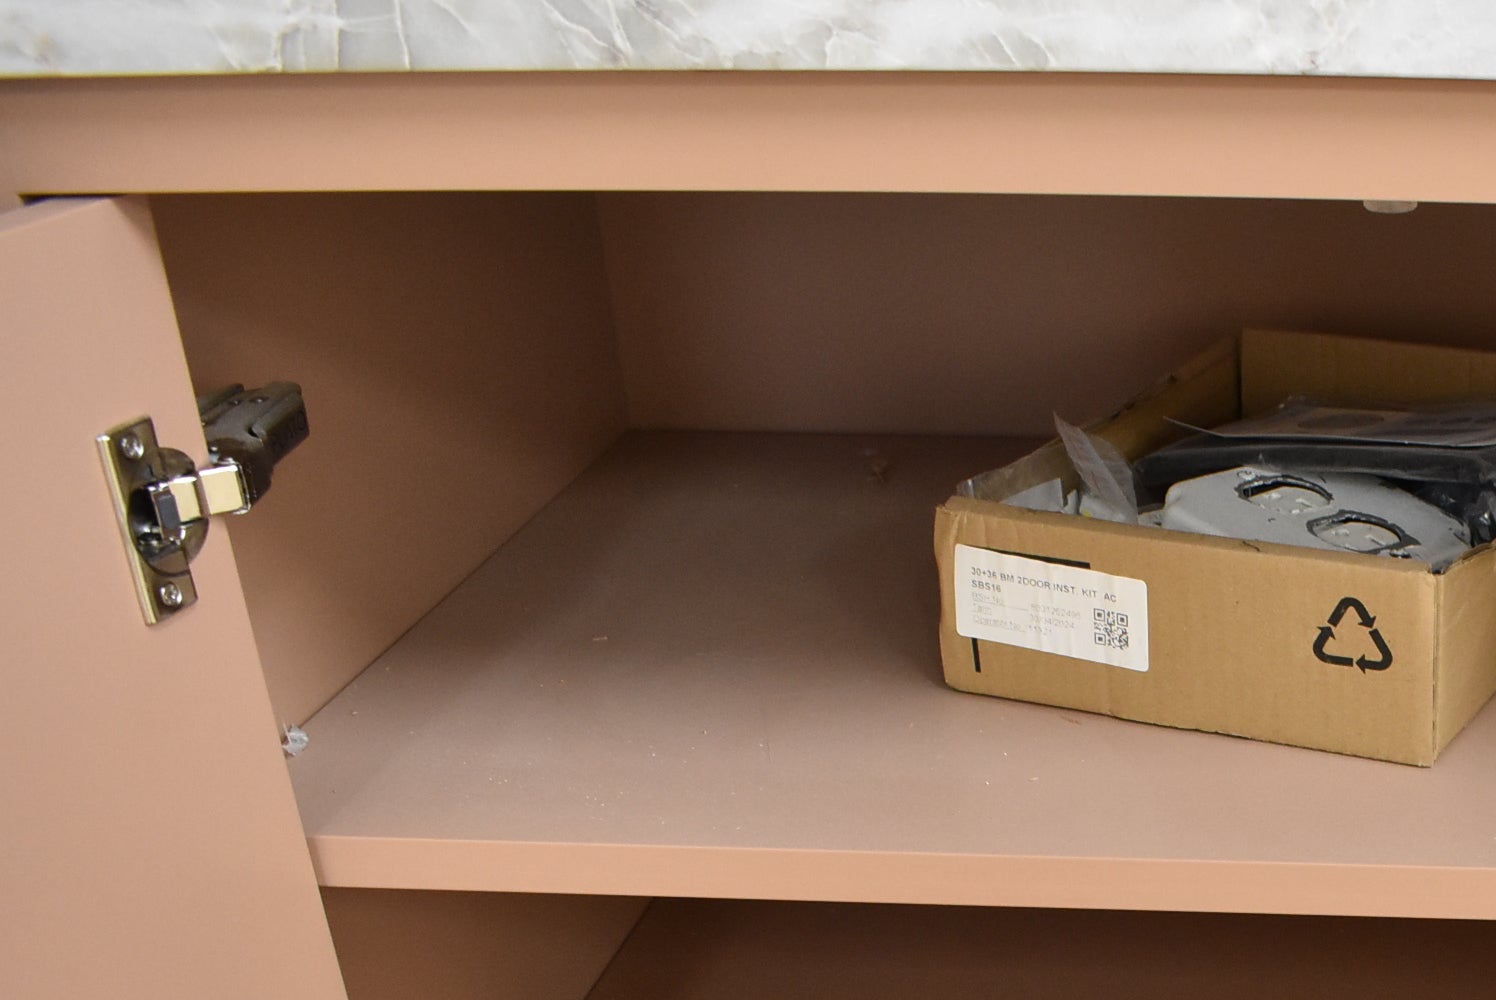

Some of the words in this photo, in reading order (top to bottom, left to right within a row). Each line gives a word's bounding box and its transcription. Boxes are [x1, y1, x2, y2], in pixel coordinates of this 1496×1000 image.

[971, 580, 1002, 593] SBS16
[1000, 572, 1015, 582] BM
[1018, 576, 1051, 590] 2DOOR
[1082, 589, 1097, 599] KIT
[1104, 594, 1117, 603] AC
